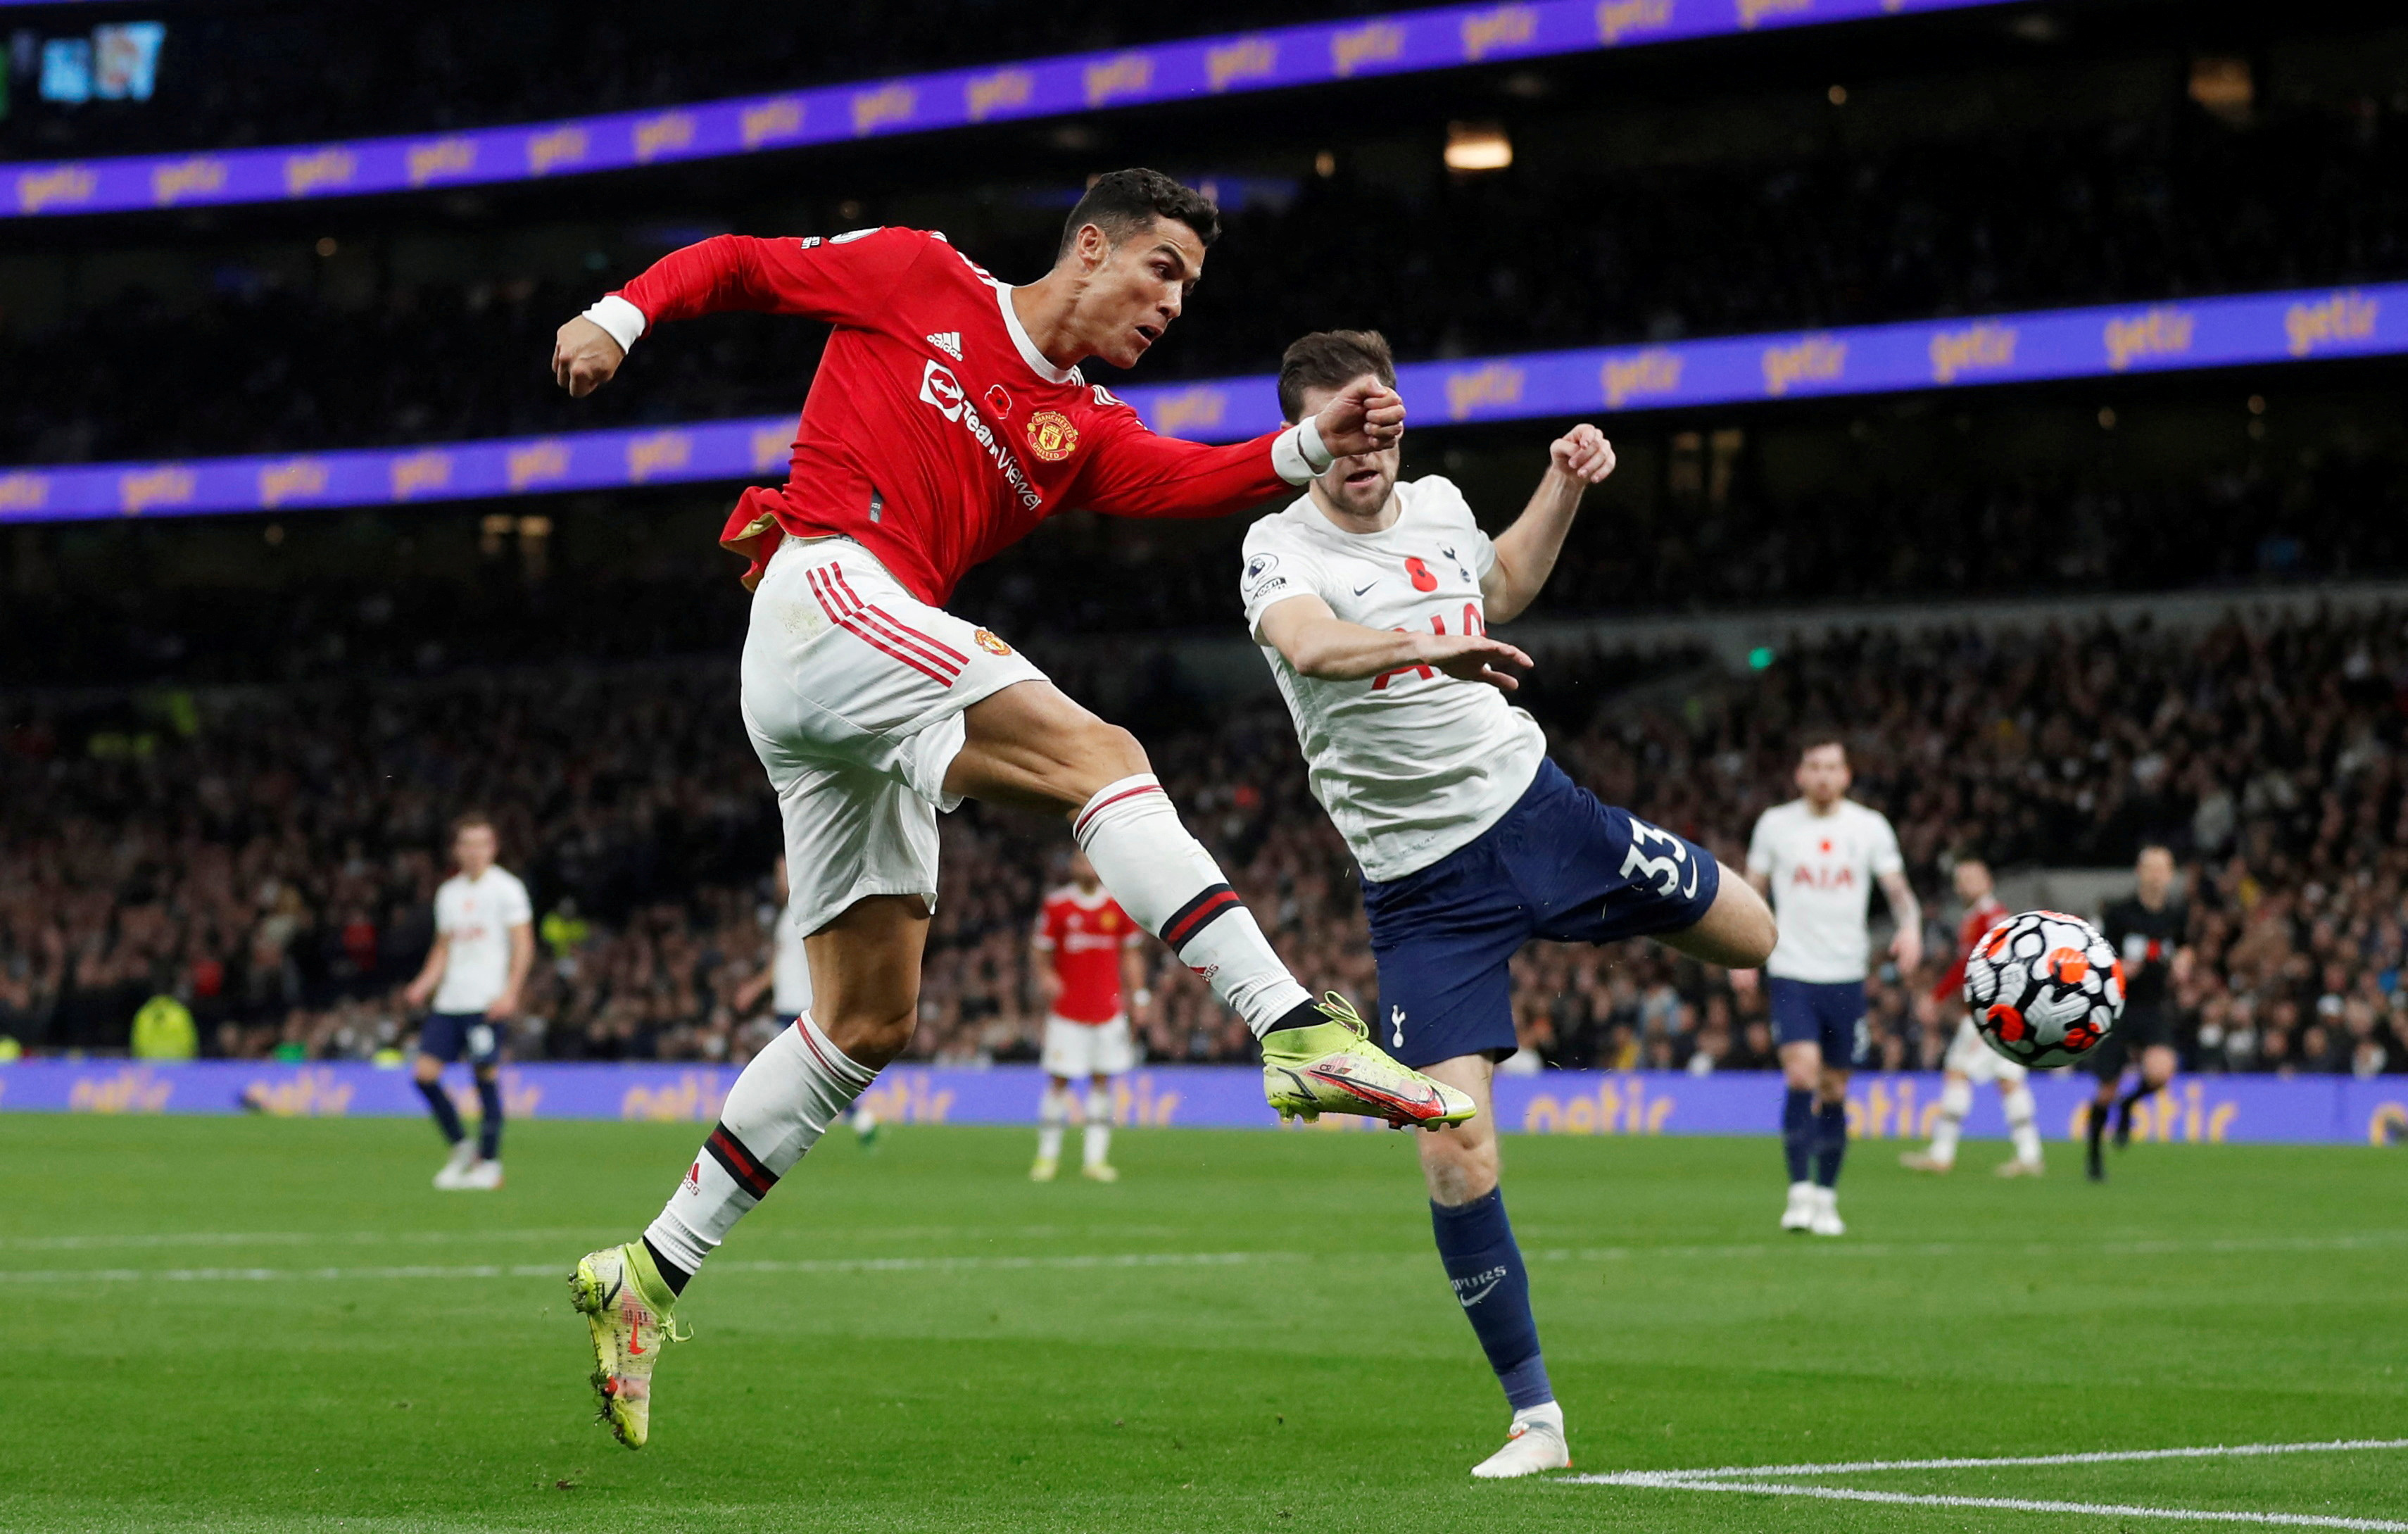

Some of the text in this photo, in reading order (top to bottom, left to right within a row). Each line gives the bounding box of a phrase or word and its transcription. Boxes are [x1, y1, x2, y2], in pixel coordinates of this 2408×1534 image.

[926, 334, 964, 362] adidas
[1035, 414, 1074, 439] MANCHESTER
[1033, 442, 1059, 459] UNITED
[1620, 817, 1687, 897] 33
